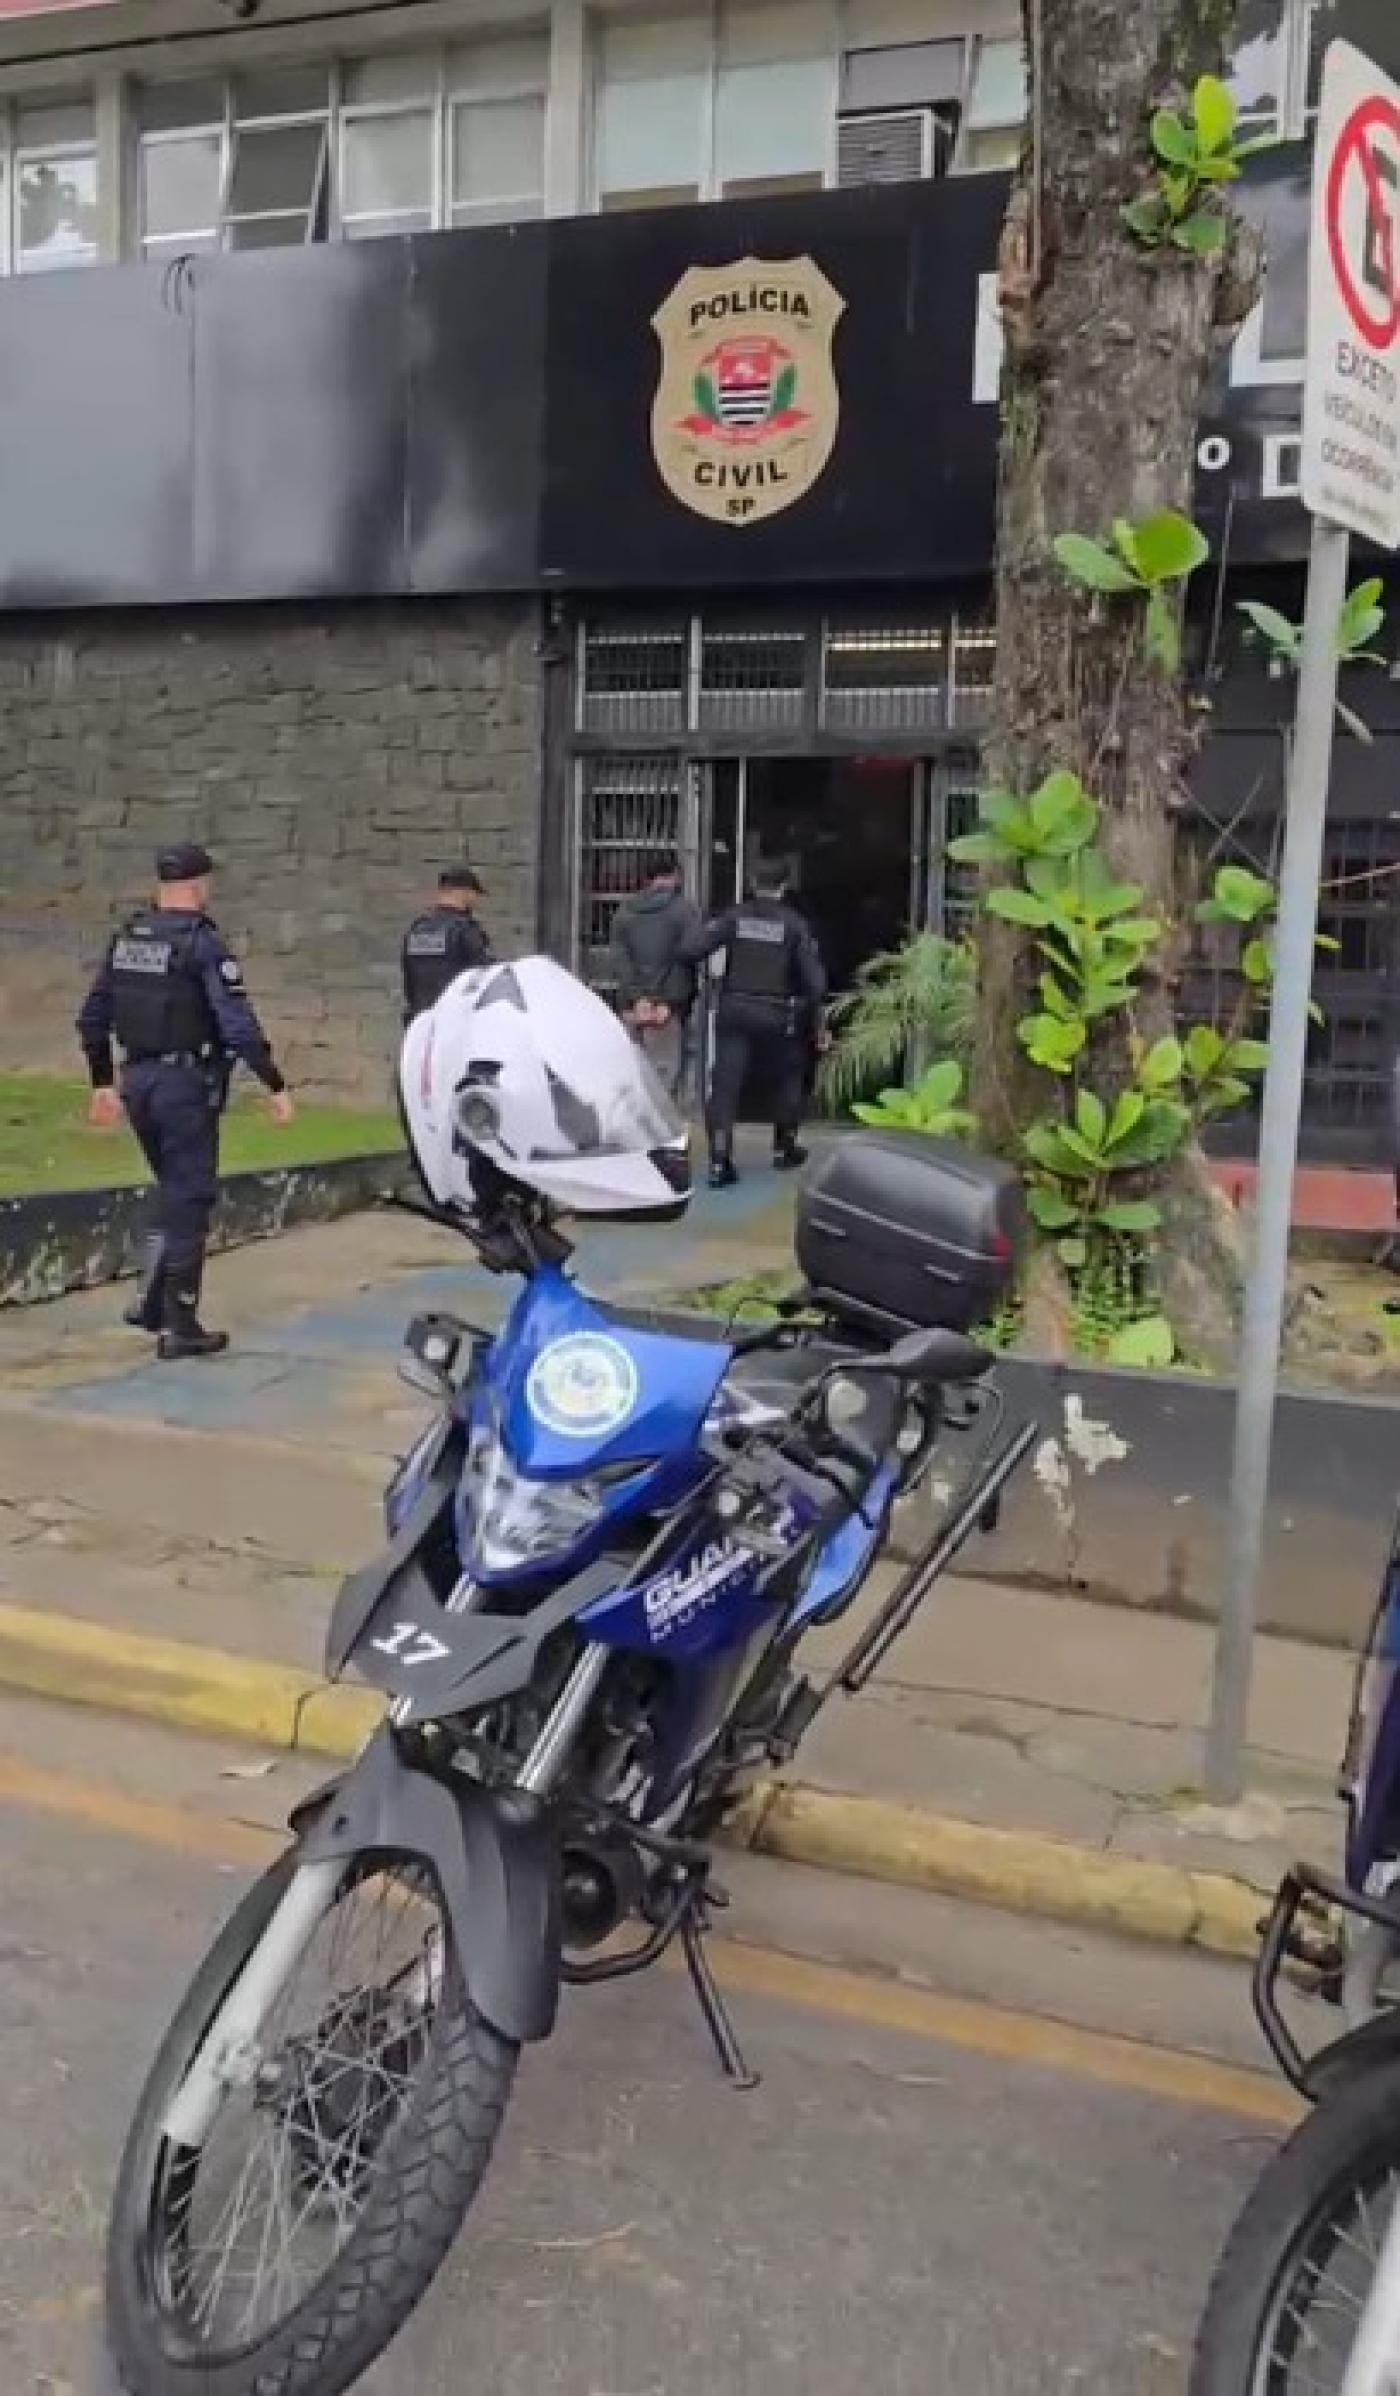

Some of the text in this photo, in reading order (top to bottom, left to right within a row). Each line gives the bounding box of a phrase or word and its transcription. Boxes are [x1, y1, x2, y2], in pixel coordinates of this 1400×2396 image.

[690, 282, 809, 326] POLÍCIA
[694, 459, 788, 487] CIVIL
[726, 497, 755, 518] SP
[370, 1622, 451, 1664] 17
